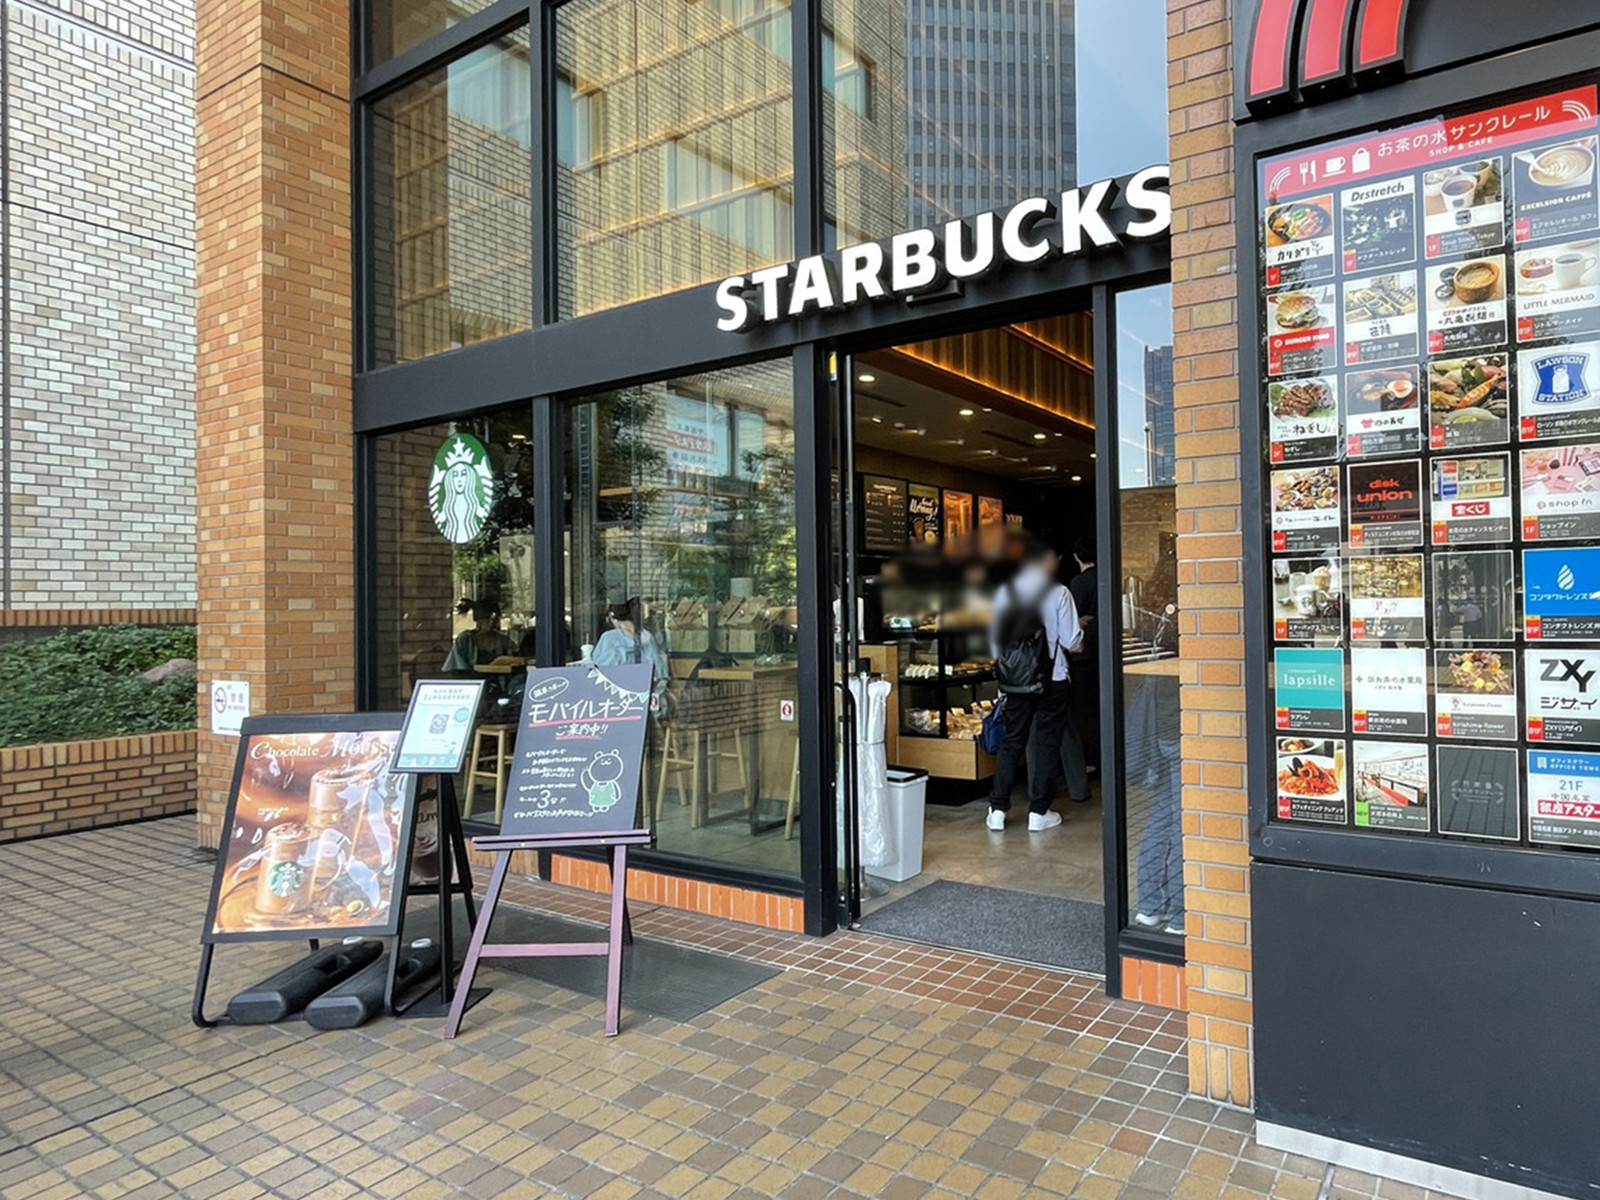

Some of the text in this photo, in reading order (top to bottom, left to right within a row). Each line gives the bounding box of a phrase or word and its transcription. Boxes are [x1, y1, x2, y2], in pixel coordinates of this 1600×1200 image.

[1377, 106, 1551, 158] お茶の水サンクレール
[1429, 144, 1454, 157] SHOP
[716, 164, 1171, 332] STARBUCKS
[1523, 293, 1596, 310] LITTLE MERMAID
[1536, 355, 1584, 369] LAWSON
[1538, 390, 1588, 402] STATION
[1369, 478, 1400, 489] disk
[1356, 489, 1413, 503] union
[1454, 503, 1486, 516] 宝くじ
[1548, 499, 1578, 509] shop
[1283, 673, 1336, 688] lapsille
[1540, 659, 1596, 693] ZXY
[1540, 696, 1598, 710] ジザイ
[528, 698, 644, 724] モバイルオーダー
[250, 741, 319, 759] Chocolate
[1559, 780, 1583, 791] 21F
